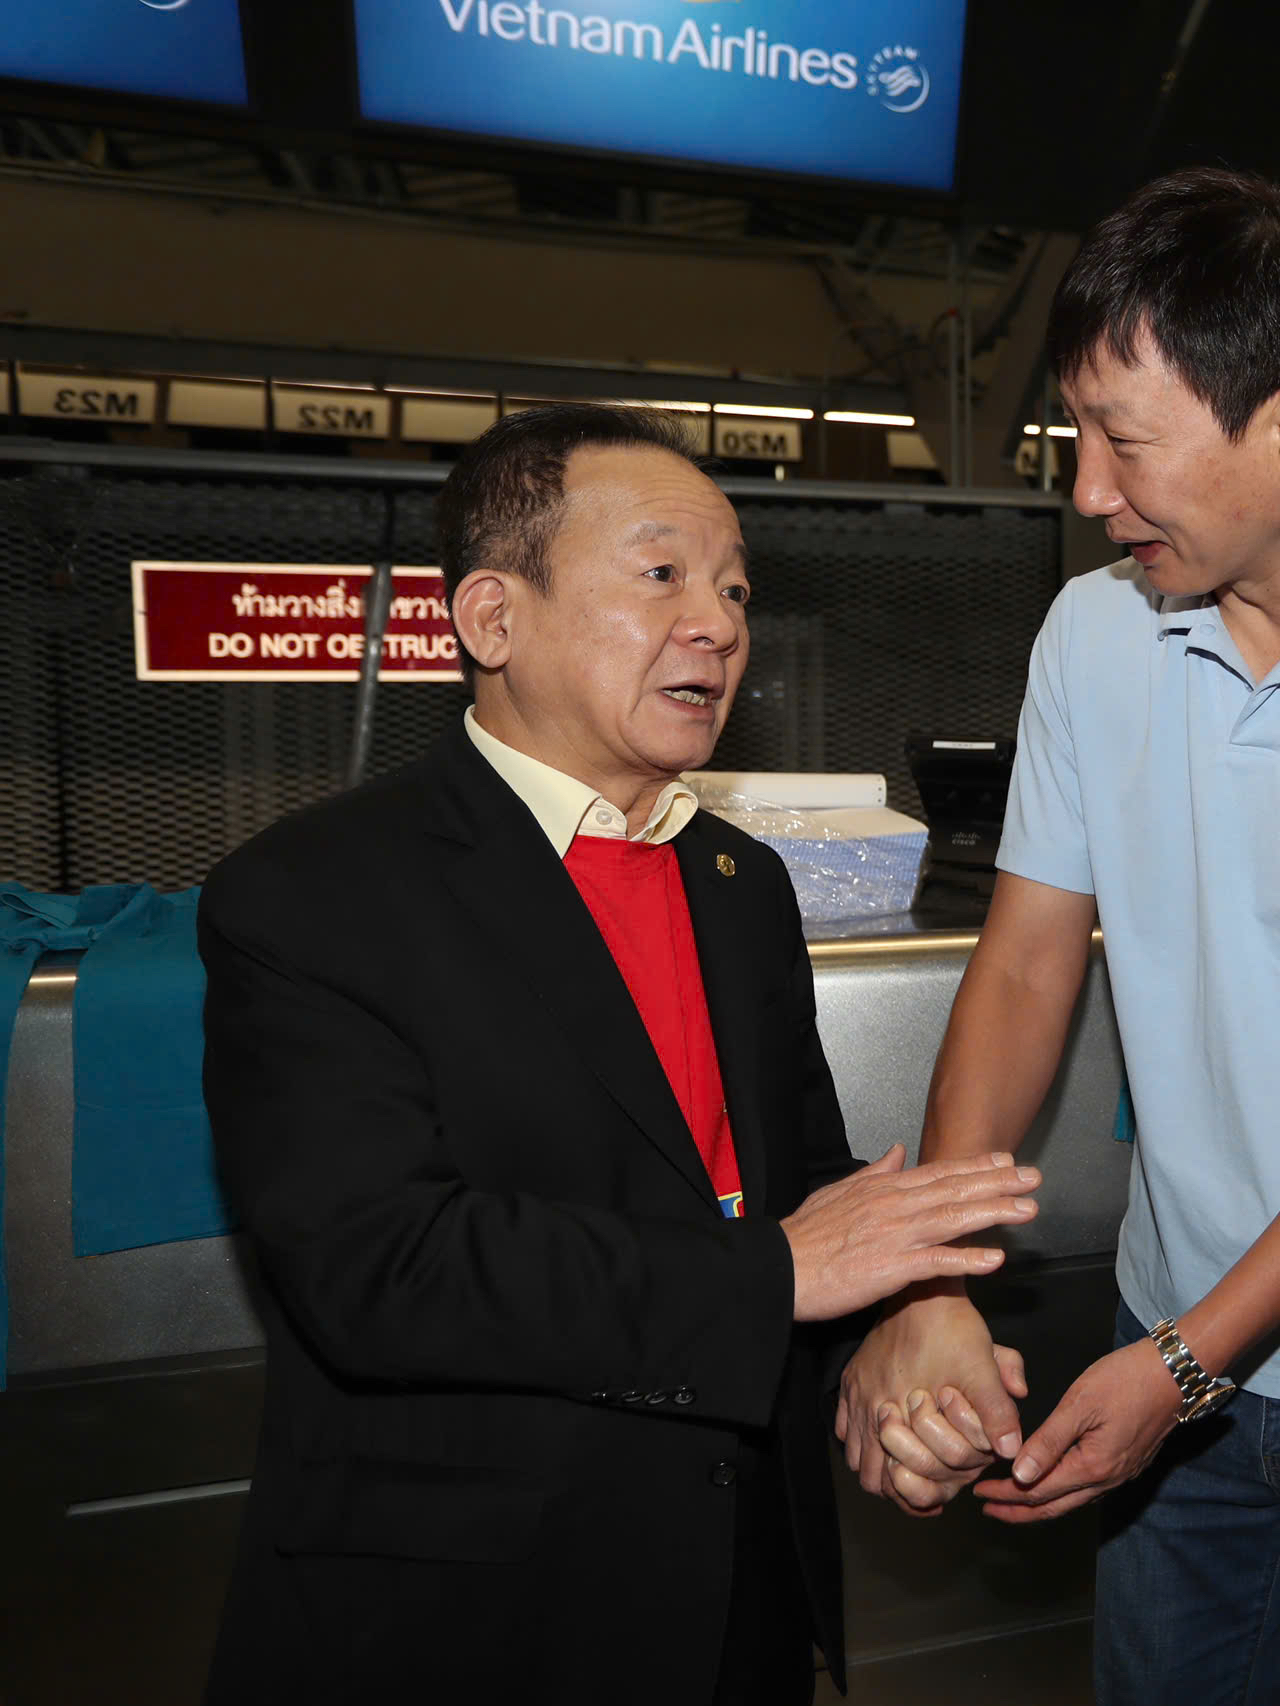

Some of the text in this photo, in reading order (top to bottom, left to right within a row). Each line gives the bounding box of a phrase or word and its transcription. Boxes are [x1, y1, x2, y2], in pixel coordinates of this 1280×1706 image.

[439, 0, 859, 90] Vietnam Airlines
[208, 632, 458, 660] DO NOT OBTRUC
